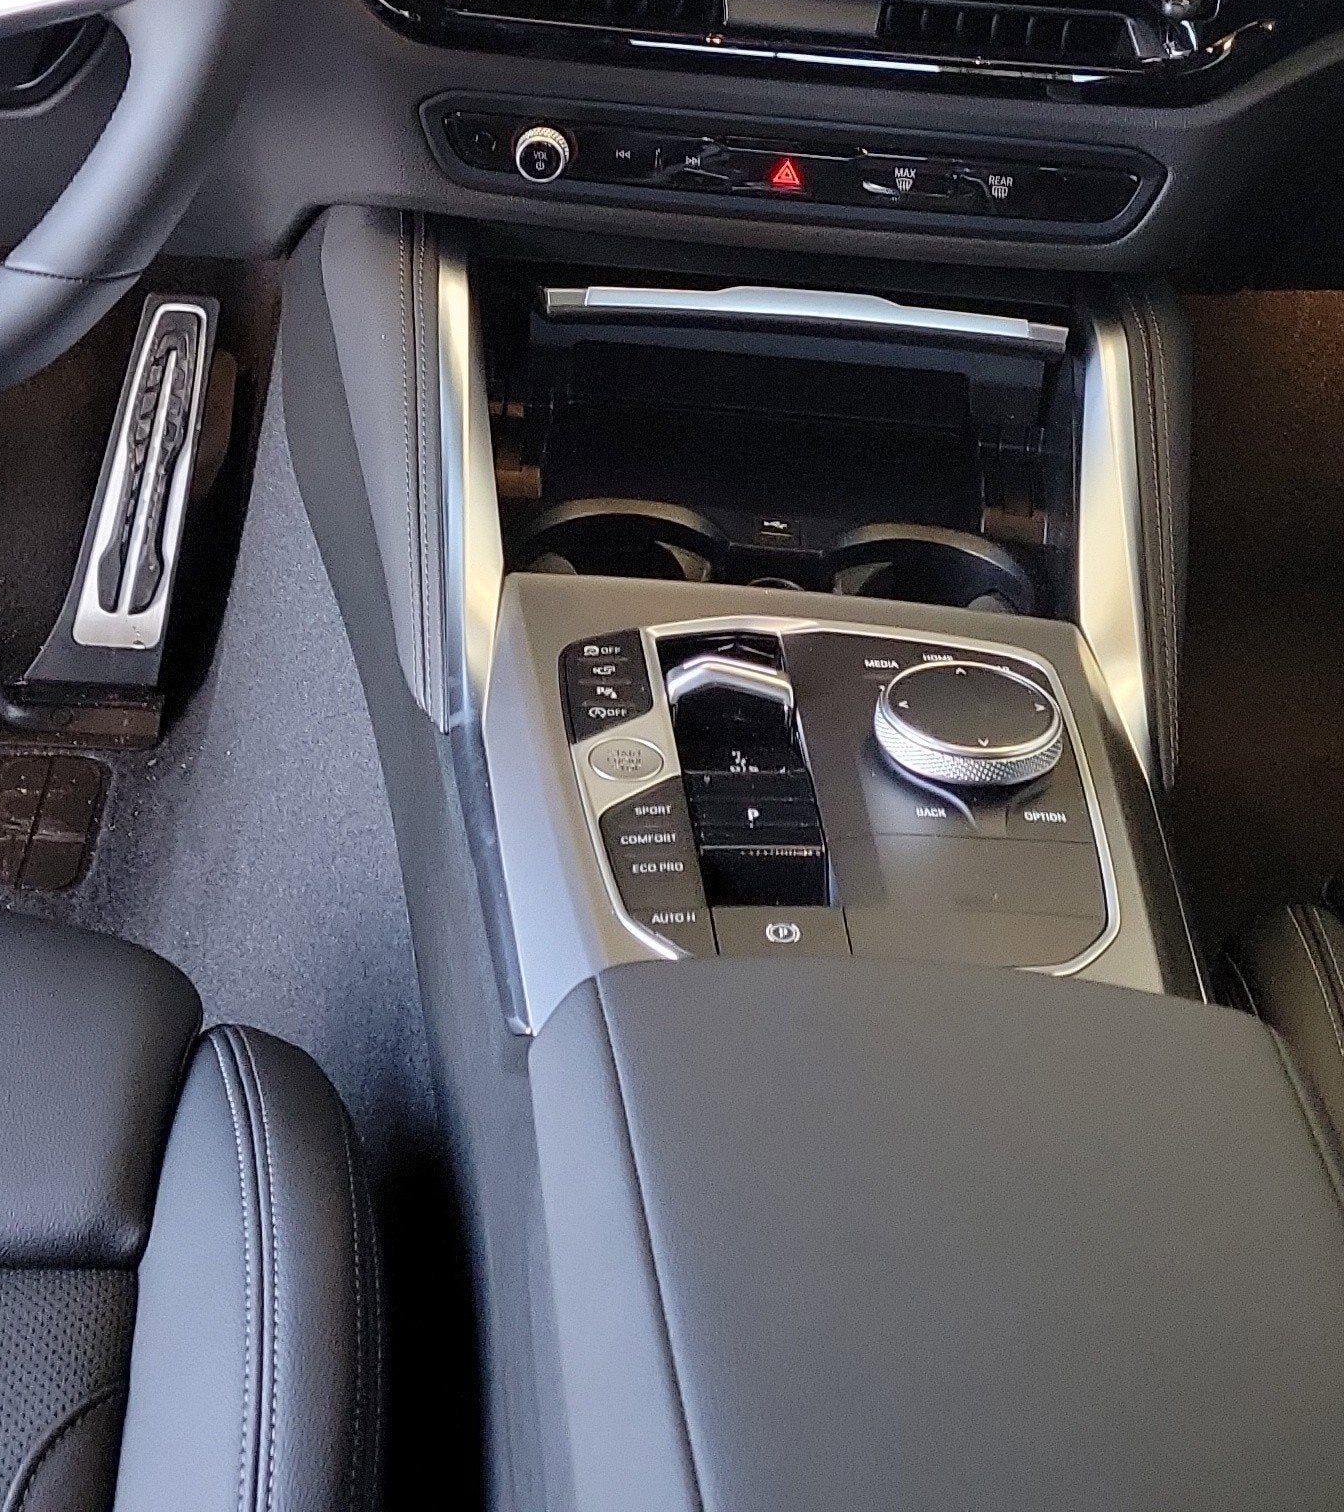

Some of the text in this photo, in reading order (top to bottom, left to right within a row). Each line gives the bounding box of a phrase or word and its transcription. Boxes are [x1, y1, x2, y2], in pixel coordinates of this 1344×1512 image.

[894, 167, 916, 179] MAX
[989, 175, 1014, 187] REAR
[864, 659, 900, 670] MEDIA
[635, 805, 672, 816] SPORT
[915, 806, 947, 819] BACK
[1024, 810, 1067, 824] OPTION
[620, 832, 676, 845] COMFORT
[632, 861, 685, 874] ECO PRO
[651, 911, 685, 925] AUTO
